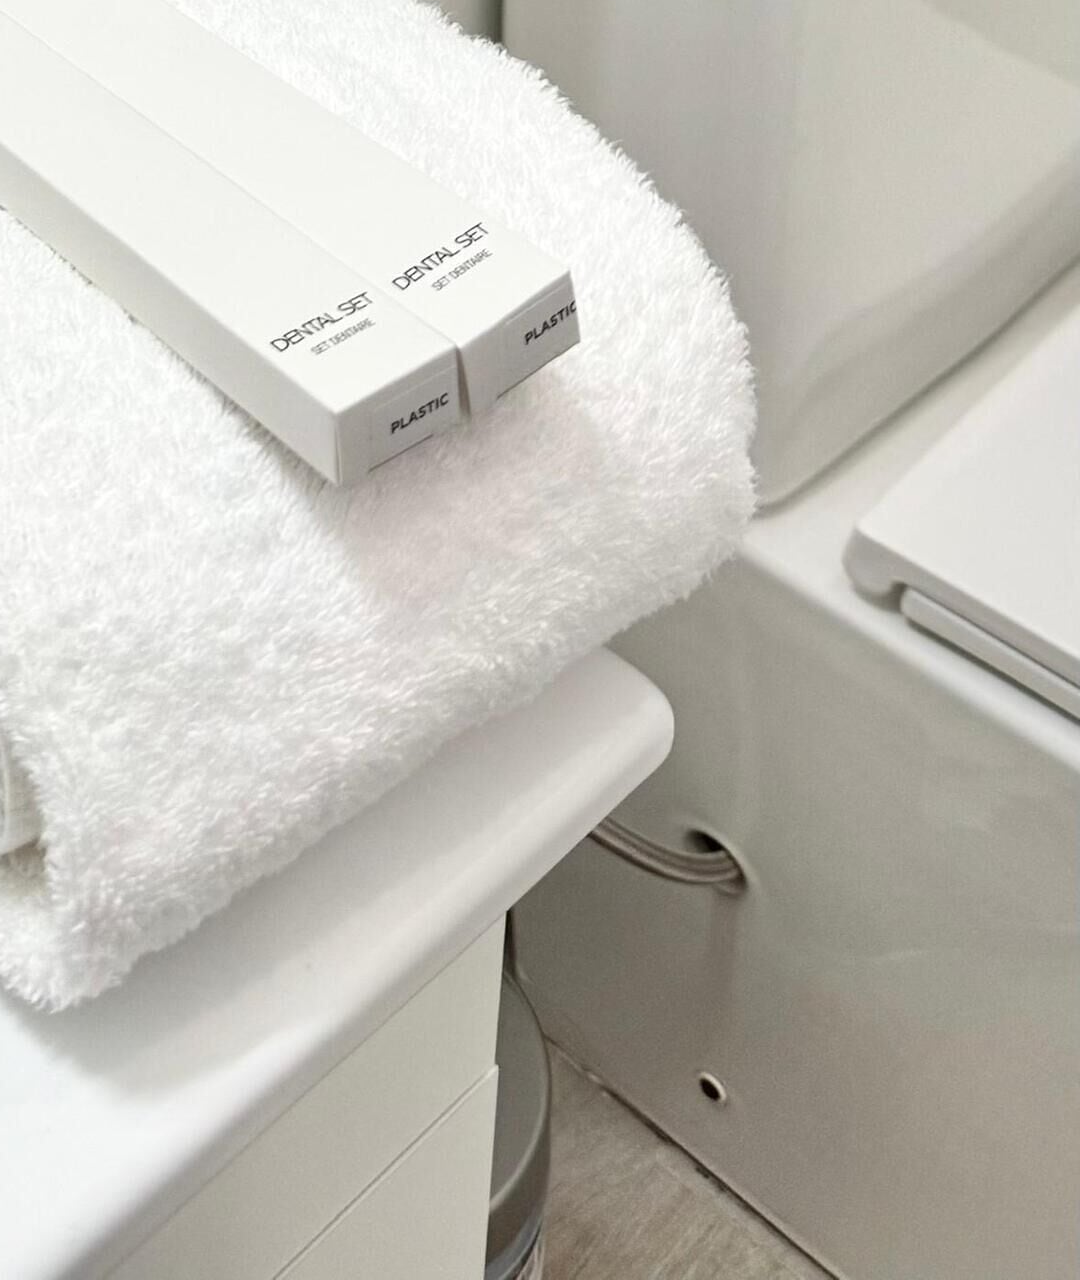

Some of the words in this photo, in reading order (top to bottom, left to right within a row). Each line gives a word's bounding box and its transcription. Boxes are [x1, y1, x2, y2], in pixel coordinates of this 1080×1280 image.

[391, 247, 461, 290] DENTAL
[454, 222, 488, 248] SET
[270, 312, 344, 352] DENTAL
[336, 291, 373, 316] SET
[524, 299, 577, 346] PLASTIC
[389, 392, 449, 435] PLASTIC
